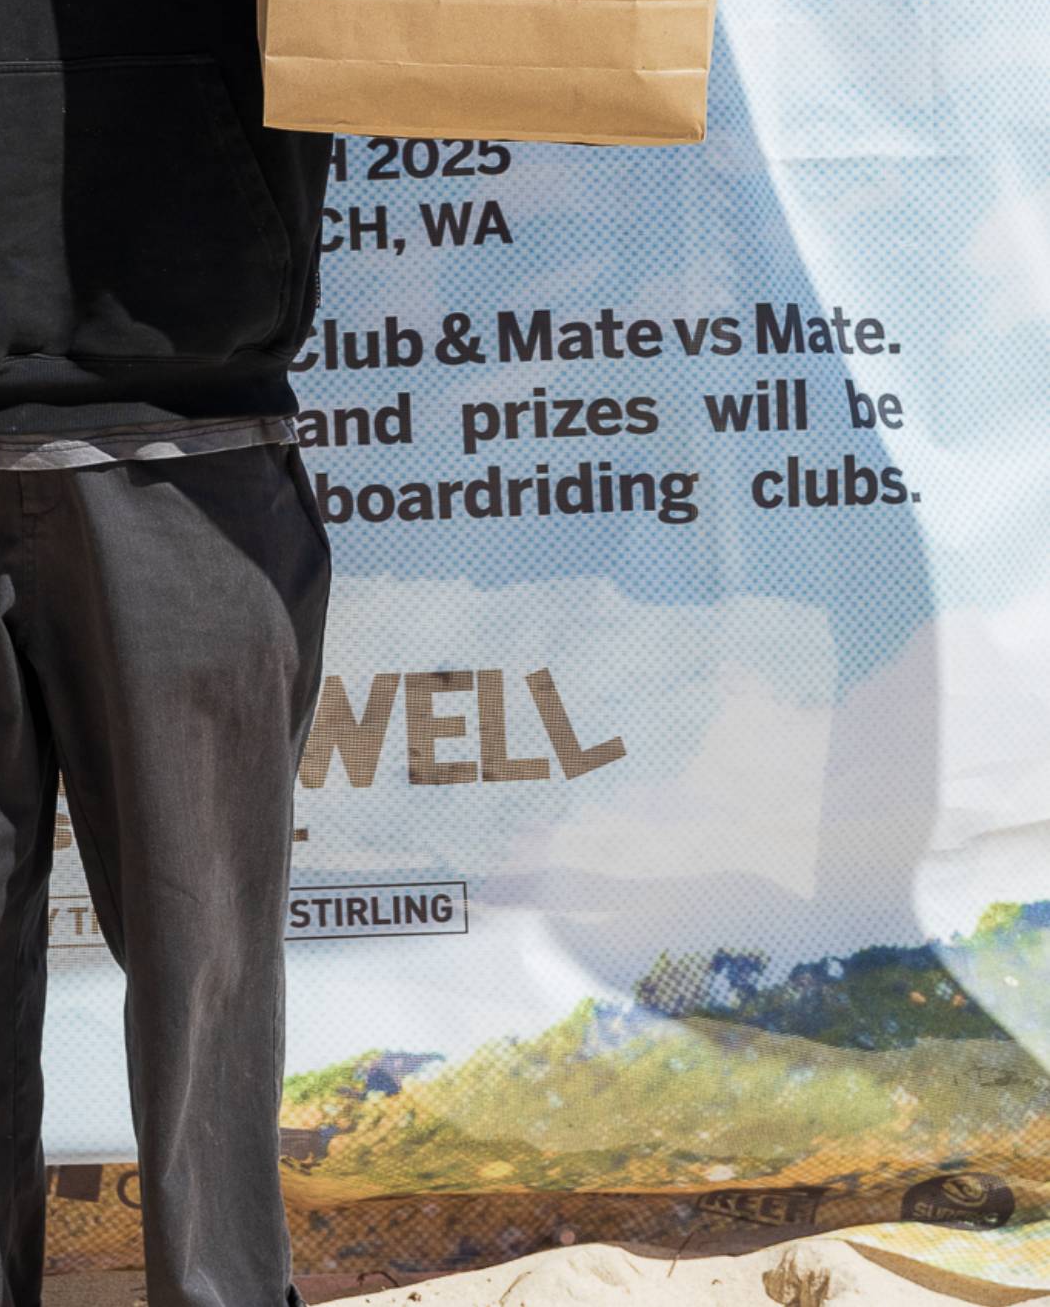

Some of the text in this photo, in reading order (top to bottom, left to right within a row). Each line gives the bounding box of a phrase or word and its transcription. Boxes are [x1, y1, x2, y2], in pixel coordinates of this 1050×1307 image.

[367, 137, 511, 180] 2025
[419, 200, 514, 247] WA
[435, 311, 486, 365] &
[497, 309, 663, 363] Mate
[673, 316, 742, 357] vs
[755, 302, 902, 356] Mate.
[297, 378, 904, 454] and prizes will be
[315, 454, 921, 525] boardriding clubs.
[289, 893, 453, 929] STIRLING
